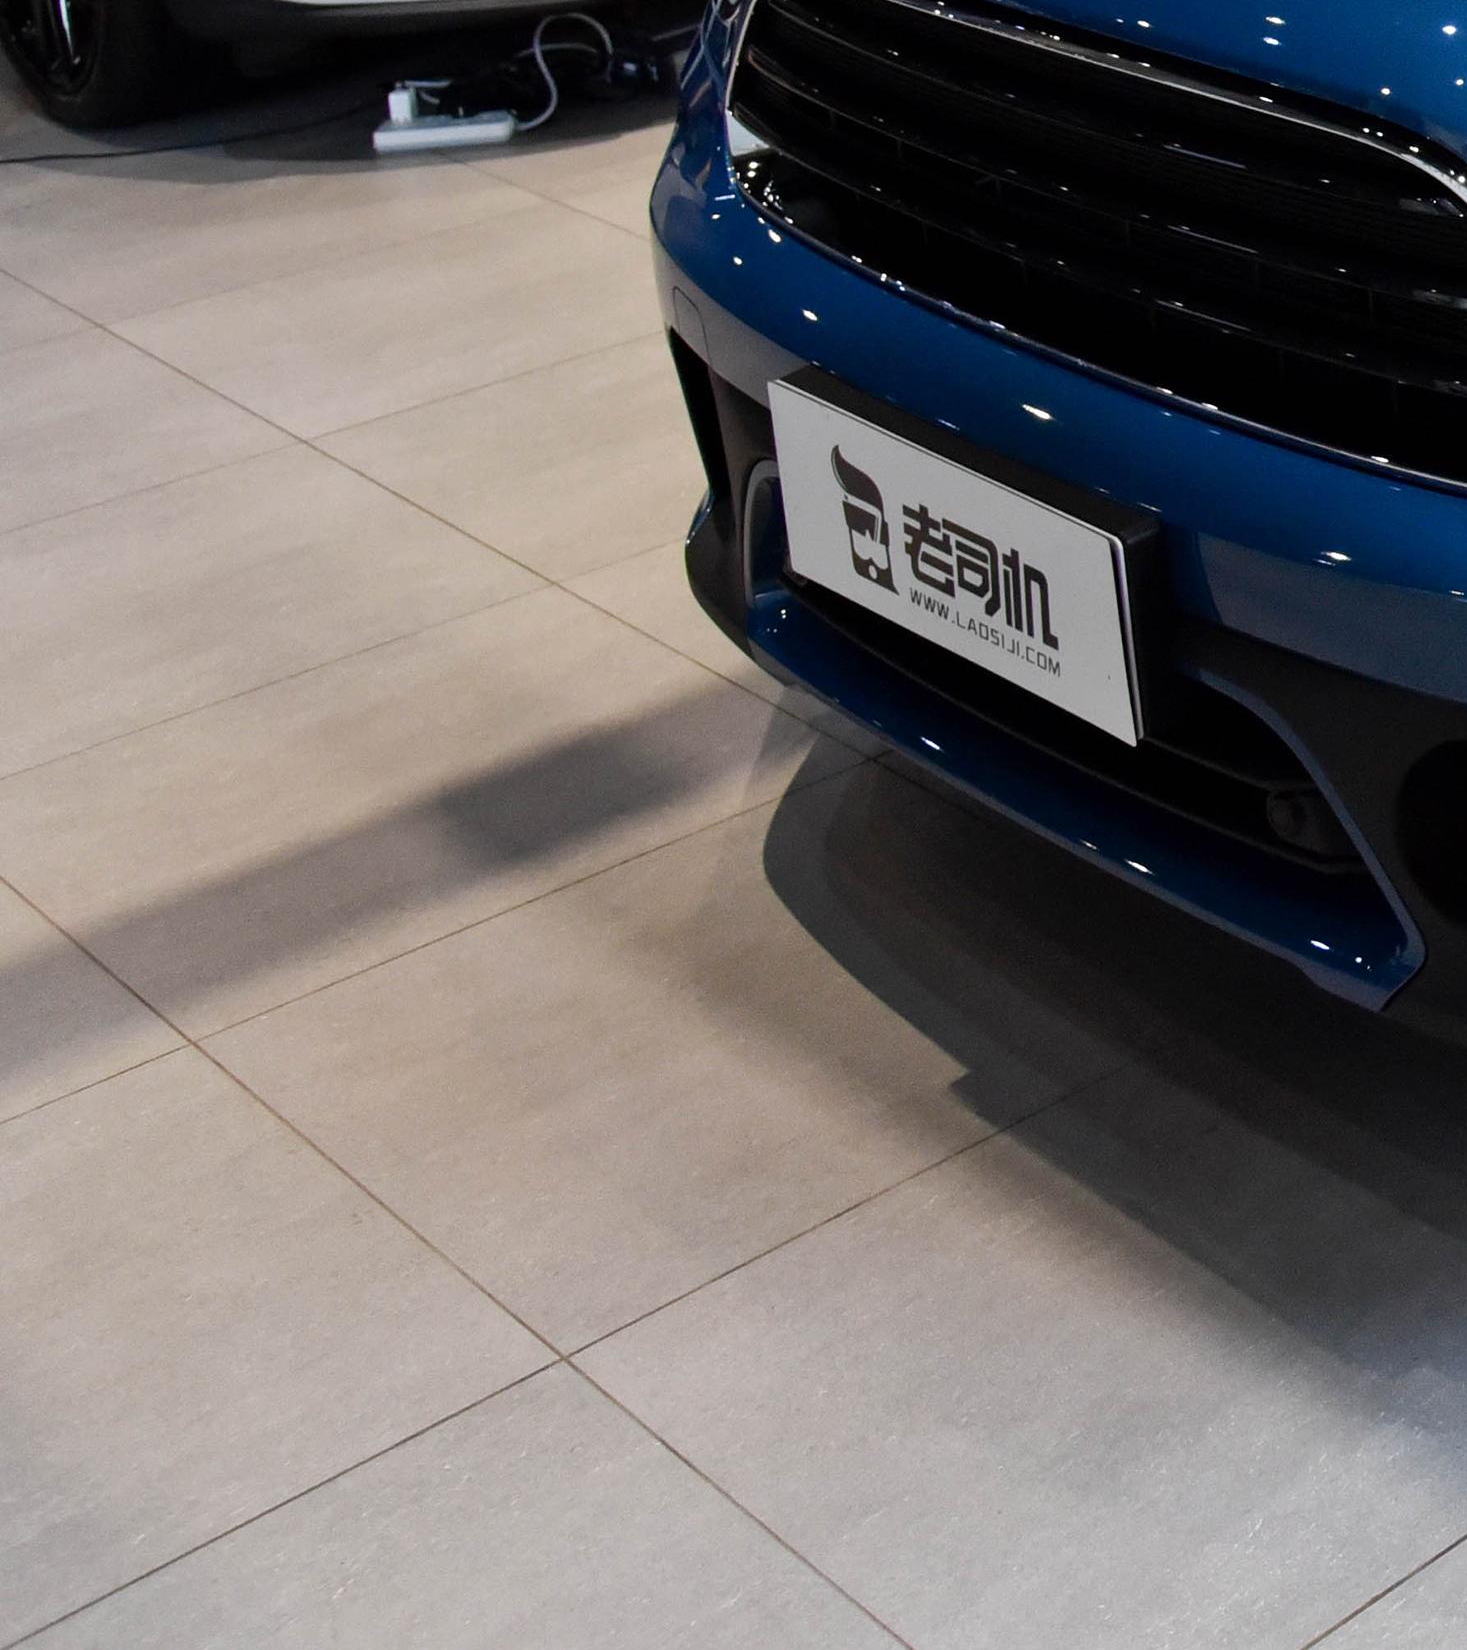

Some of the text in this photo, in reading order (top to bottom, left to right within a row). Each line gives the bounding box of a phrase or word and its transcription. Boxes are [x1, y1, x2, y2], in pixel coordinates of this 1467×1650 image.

[902, 504, 1059, 650] 老司机
[909, 586, 1061, 677] WWW.LAOSIJI.COM
